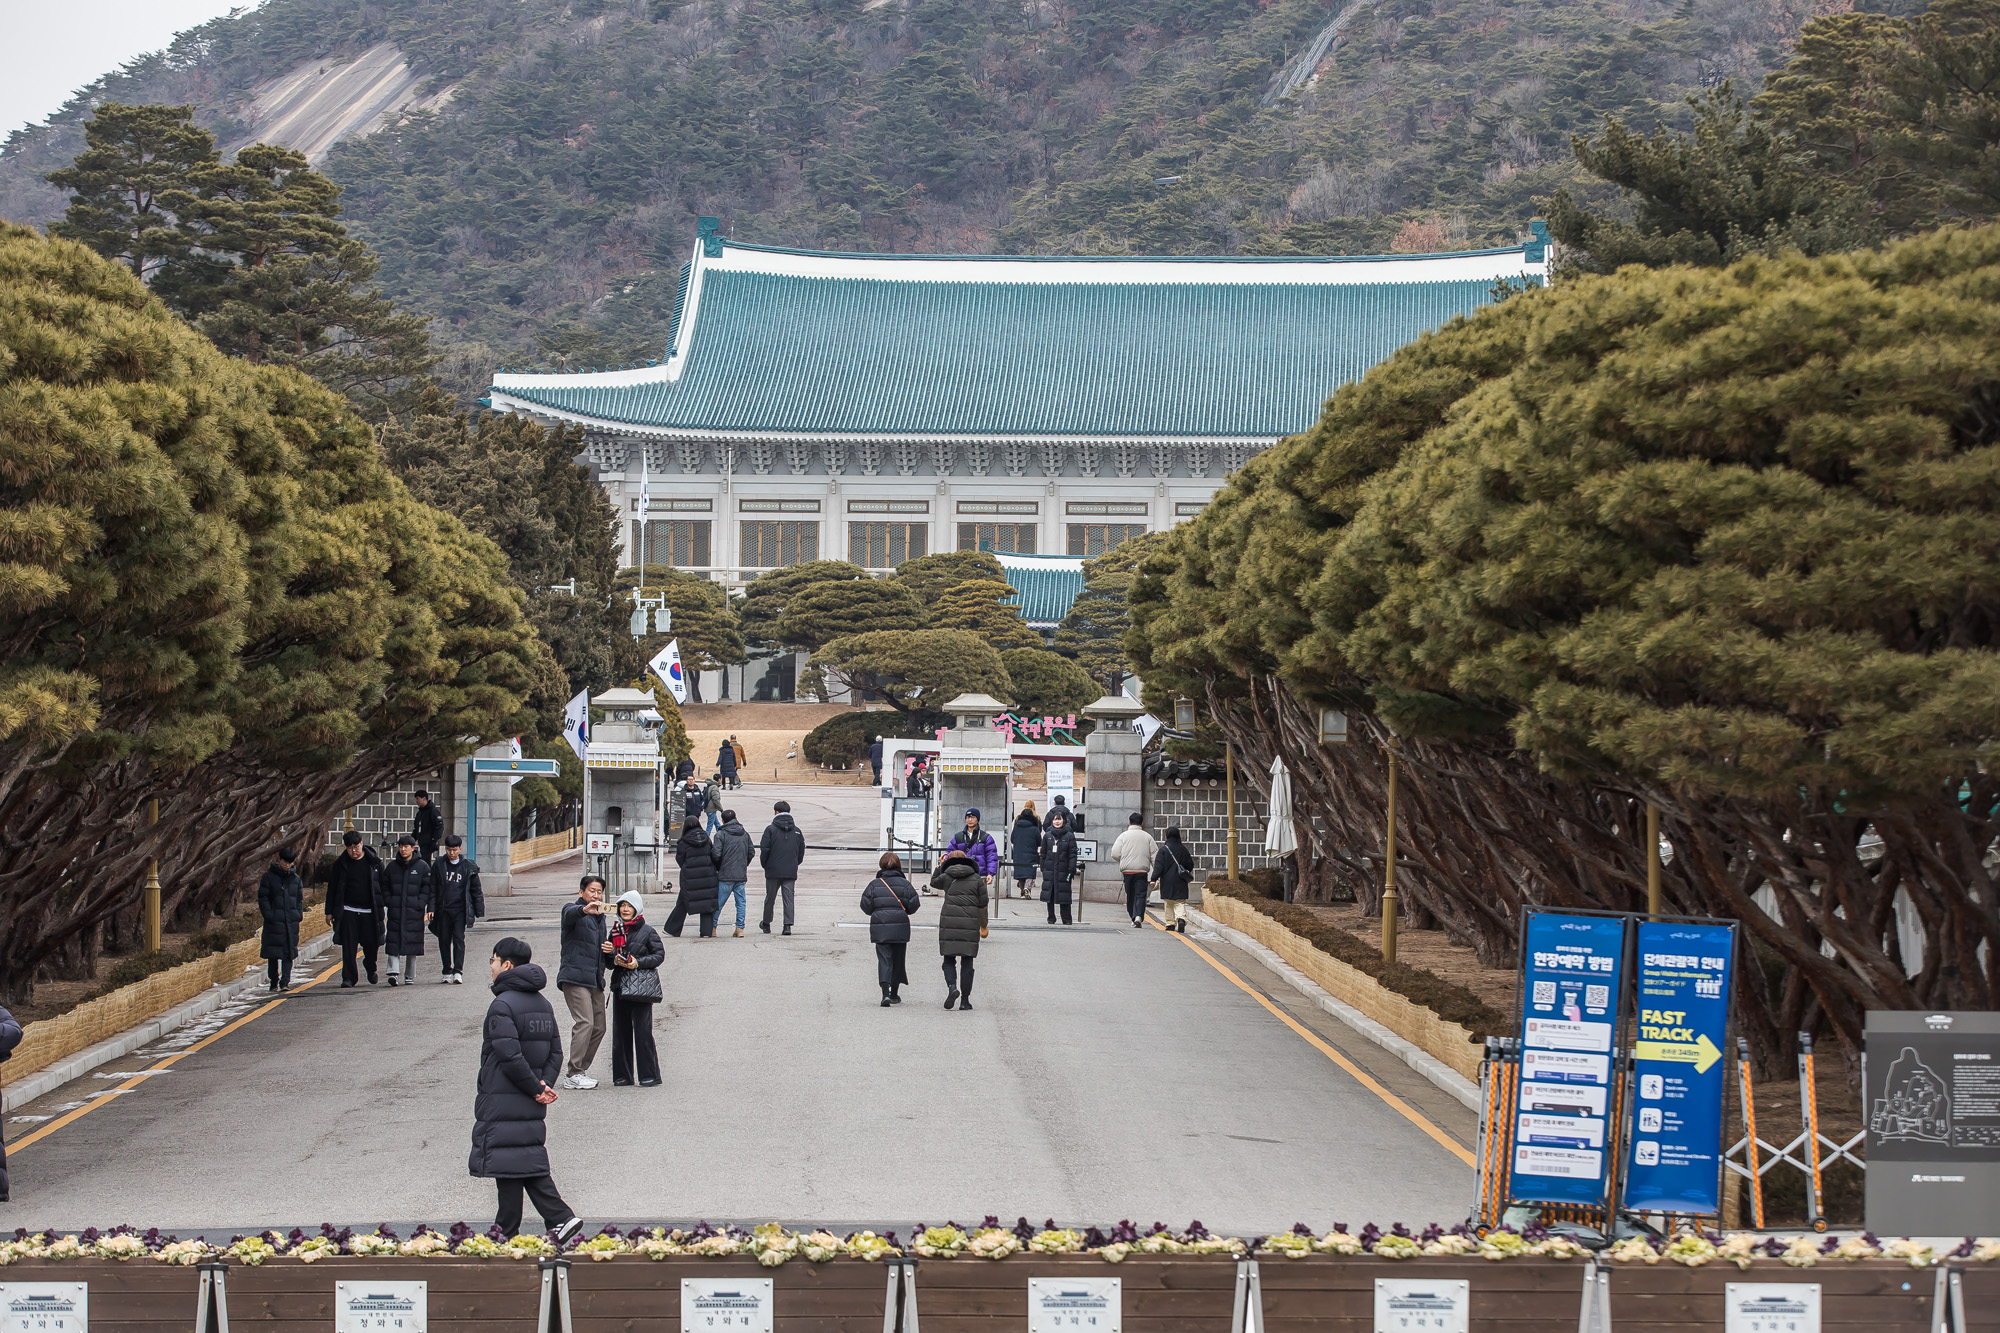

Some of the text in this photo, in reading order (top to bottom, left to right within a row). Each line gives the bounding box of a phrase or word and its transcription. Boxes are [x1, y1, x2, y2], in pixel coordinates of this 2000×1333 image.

[1534, 952, 1614, 971] 현장예약 방법
[1644, 953, 1725, 970] 단체관람객 안내
[1642, 1009, 1686, 1025] FAST
[530, 1020, 551, 1032] STAFF
[1640, 1026, 1694, 1042] TRACK
[360, 1318, 403, 1328] 청와대
[706, 1316, 749, 1326] 청와대
